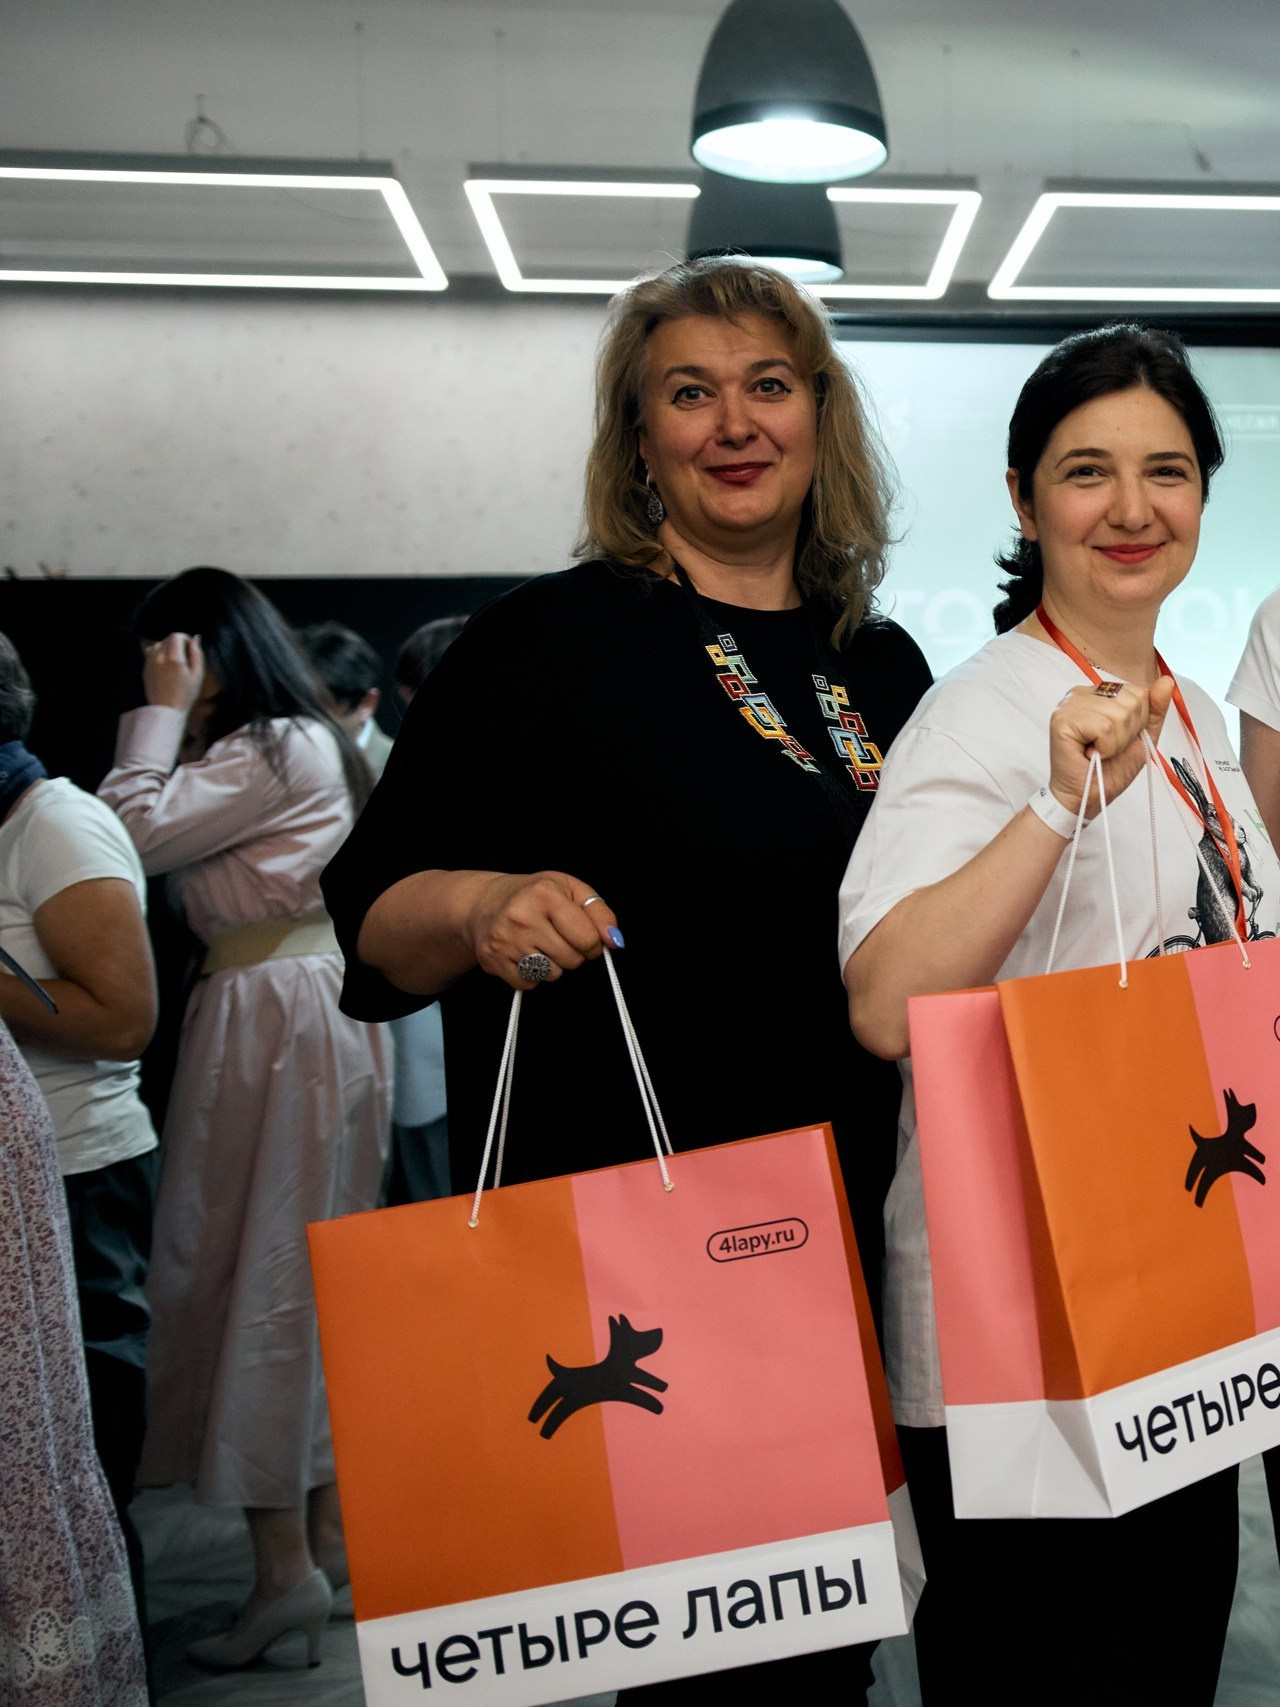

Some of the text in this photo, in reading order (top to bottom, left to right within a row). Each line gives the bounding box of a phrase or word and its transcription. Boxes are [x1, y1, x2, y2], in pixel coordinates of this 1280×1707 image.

[719, 1229, 795, 1253] 4lapy.ru
[390, 1558, 869, 1690] четыре лапы
